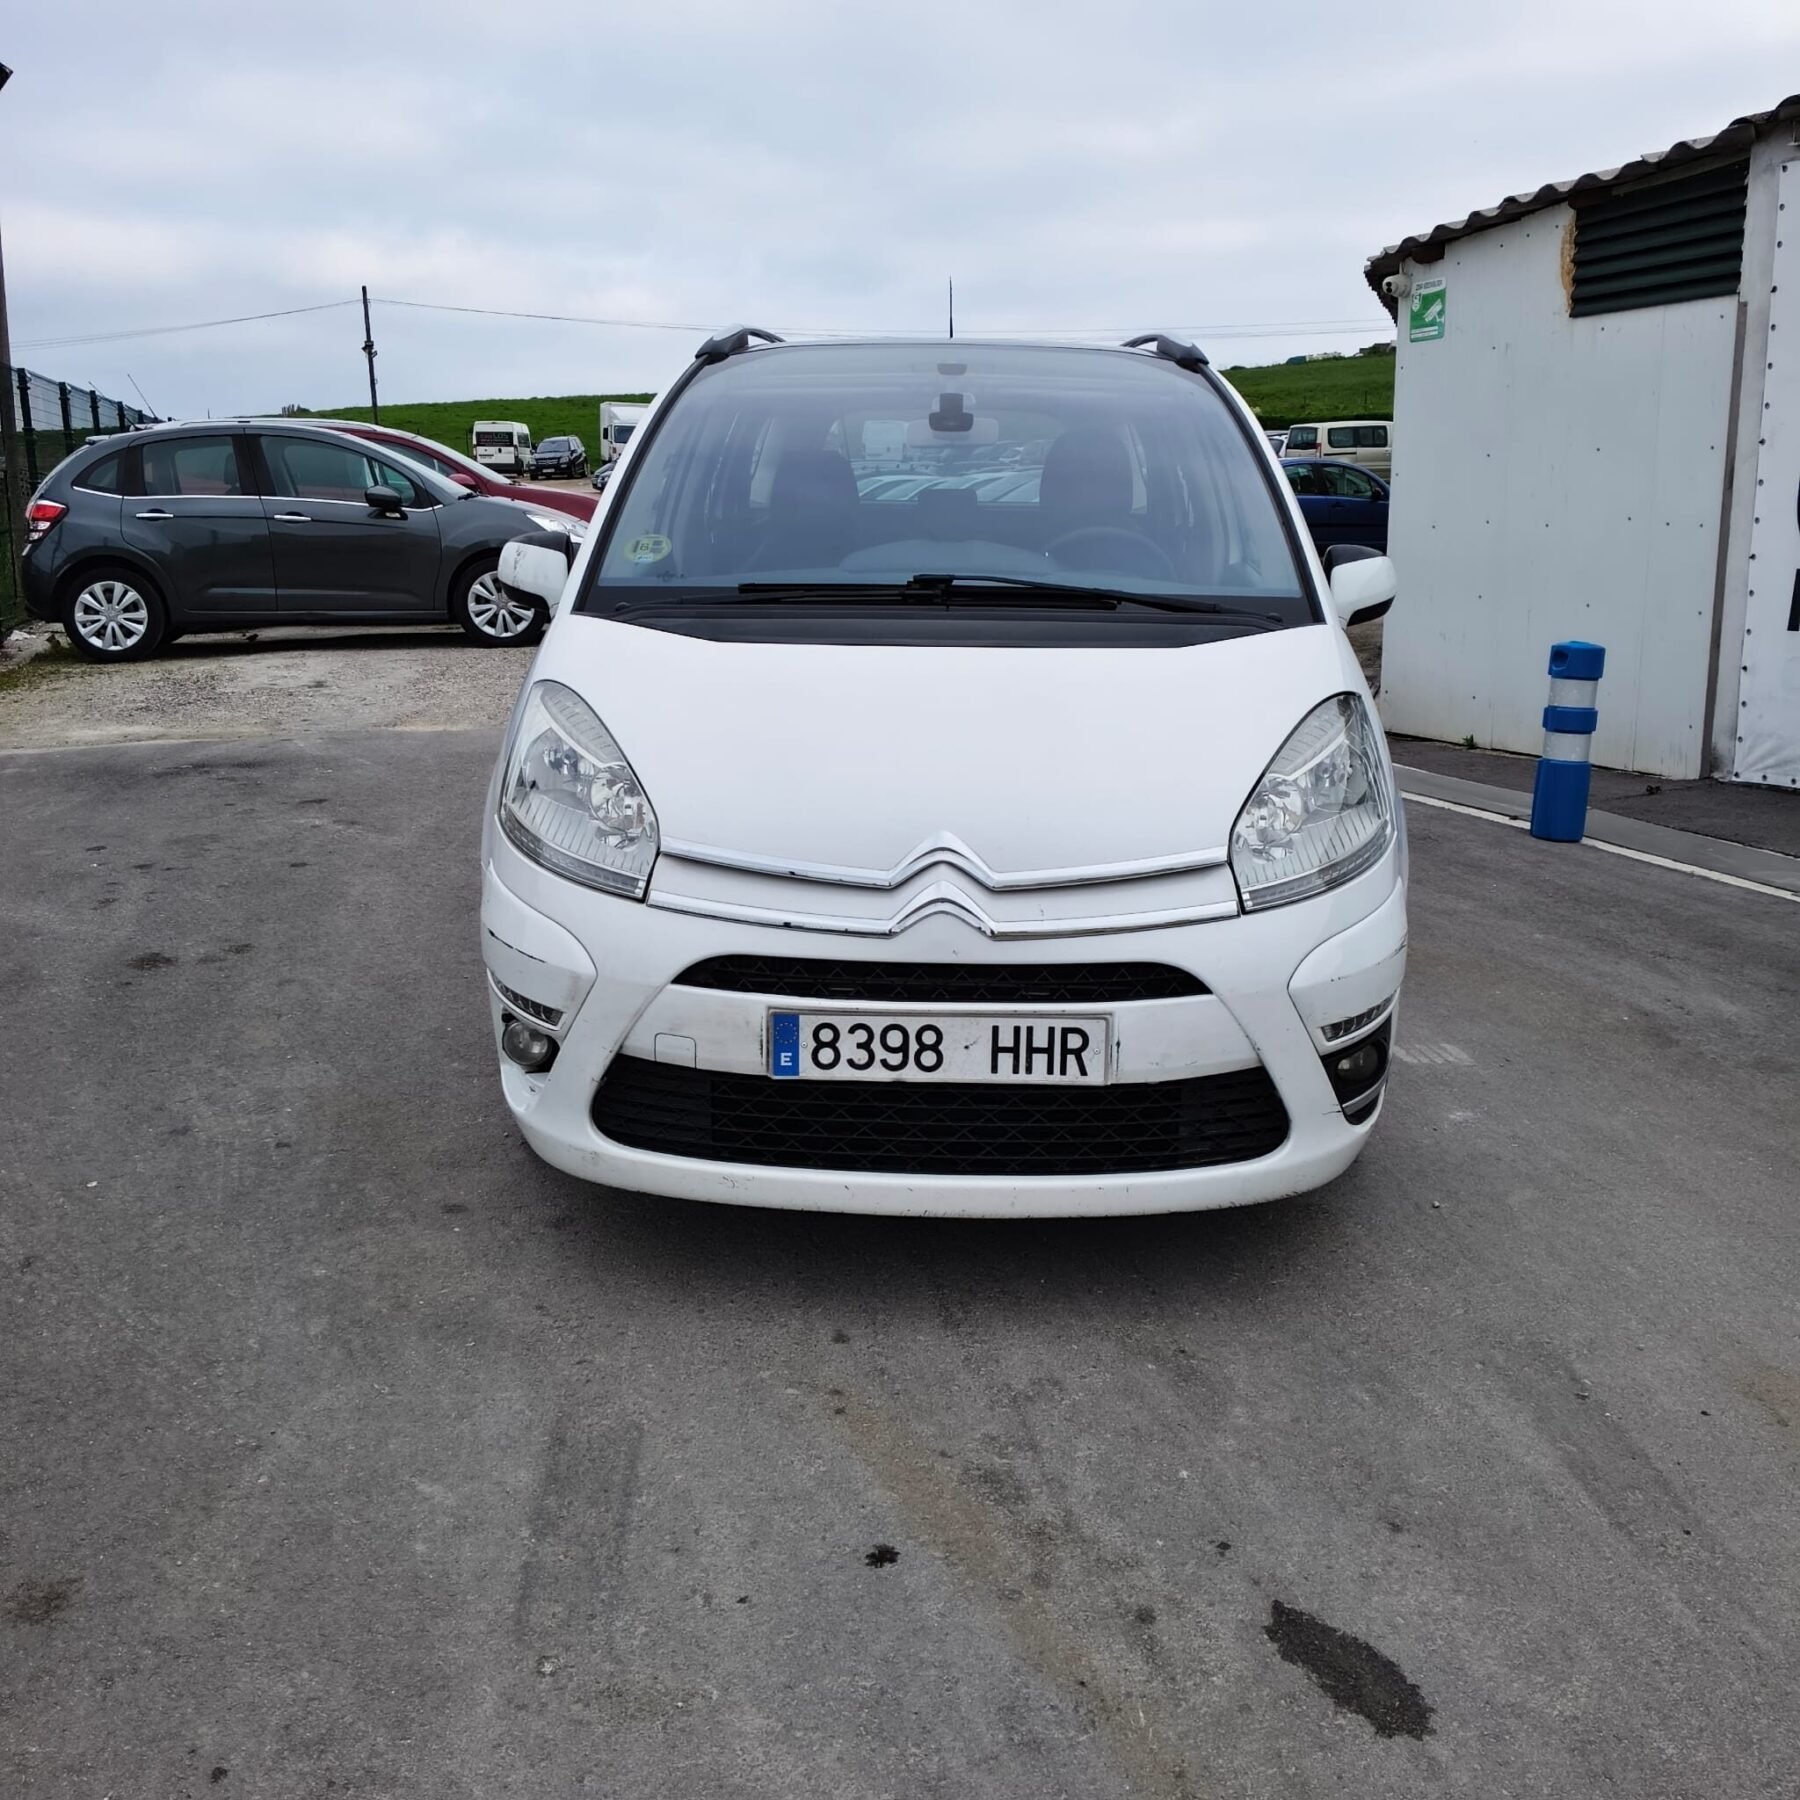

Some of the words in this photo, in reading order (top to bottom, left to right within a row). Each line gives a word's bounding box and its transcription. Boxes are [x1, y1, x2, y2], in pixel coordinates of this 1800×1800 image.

[780, 1053, 792, 1066] E
[811, 1022, 944, 1073] 8398
[990, 1025, 1090, 1077] HHR
